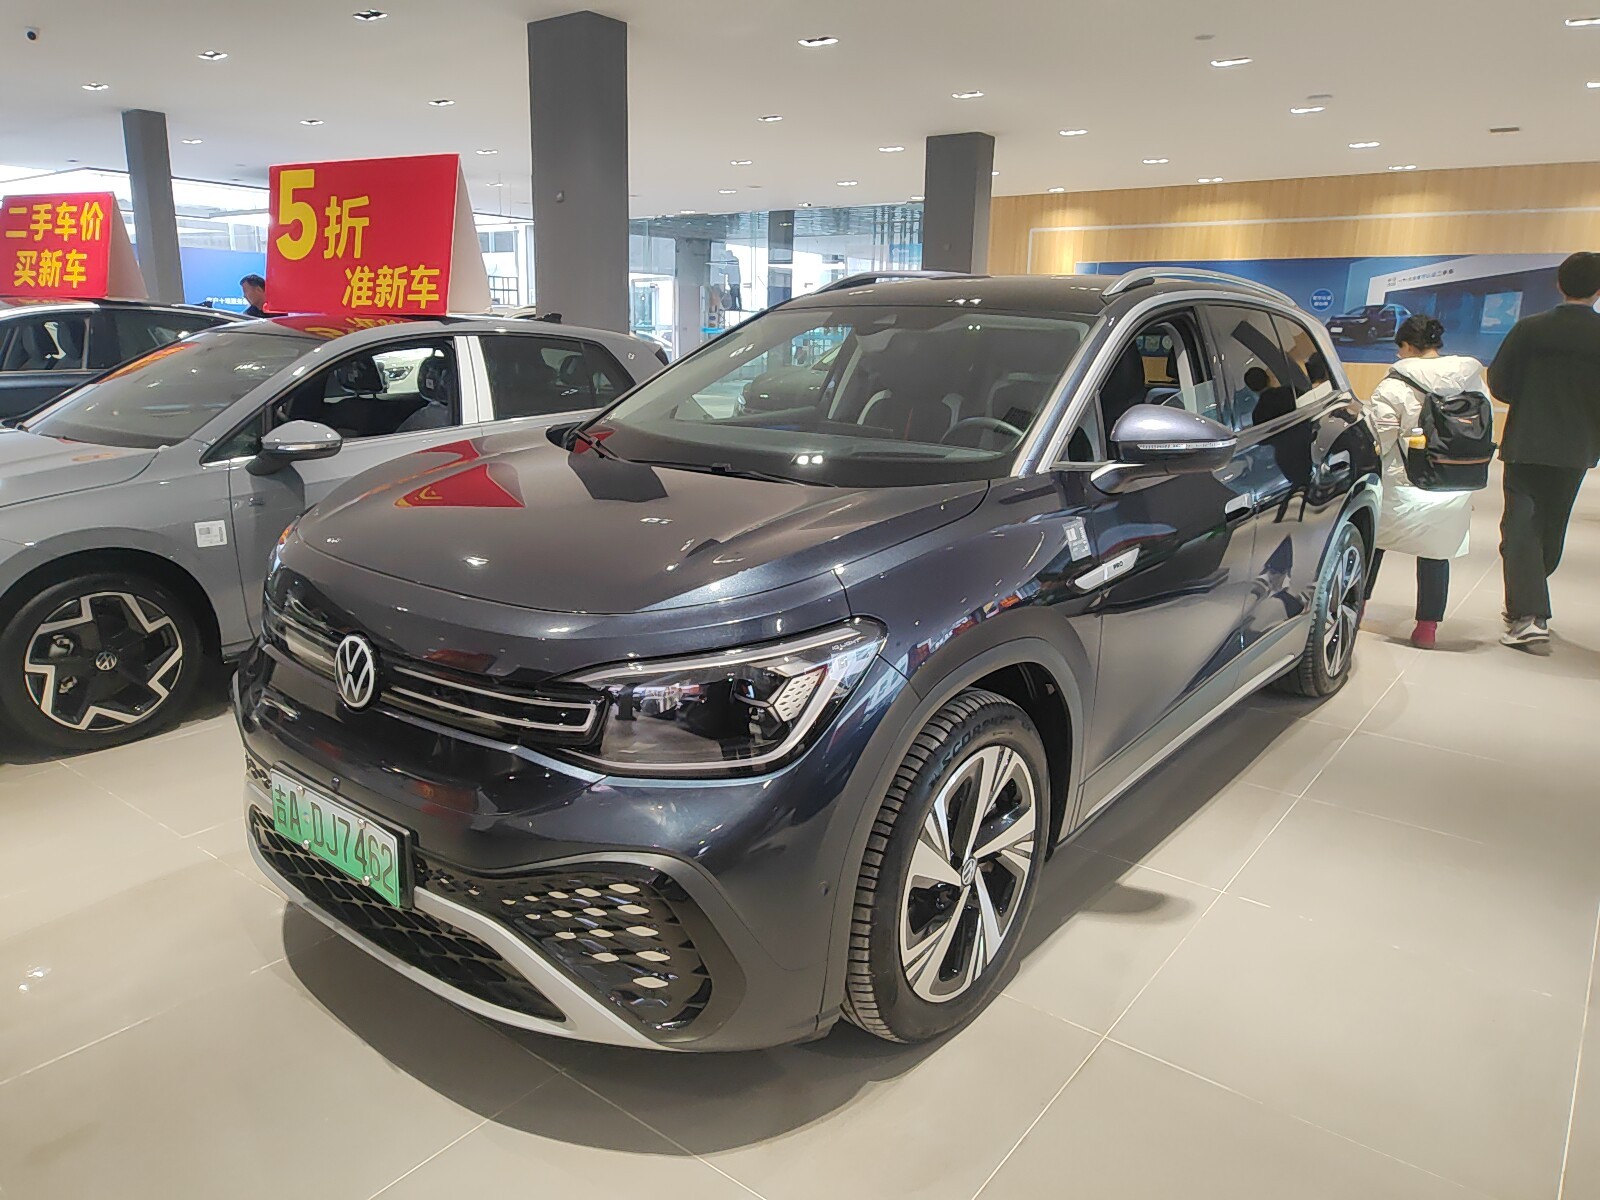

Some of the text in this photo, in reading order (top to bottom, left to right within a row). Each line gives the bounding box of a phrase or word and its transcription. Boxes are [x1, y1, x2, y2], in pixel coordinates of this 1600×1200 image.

[5, 201, 104, 242] 二手车价
[276, 169, 370, 260] 5折
[13, 249, 88, 288] 买新车
[342, 264, 440, 309] 准新车
[1113, 560, 1123, 570] PRO
